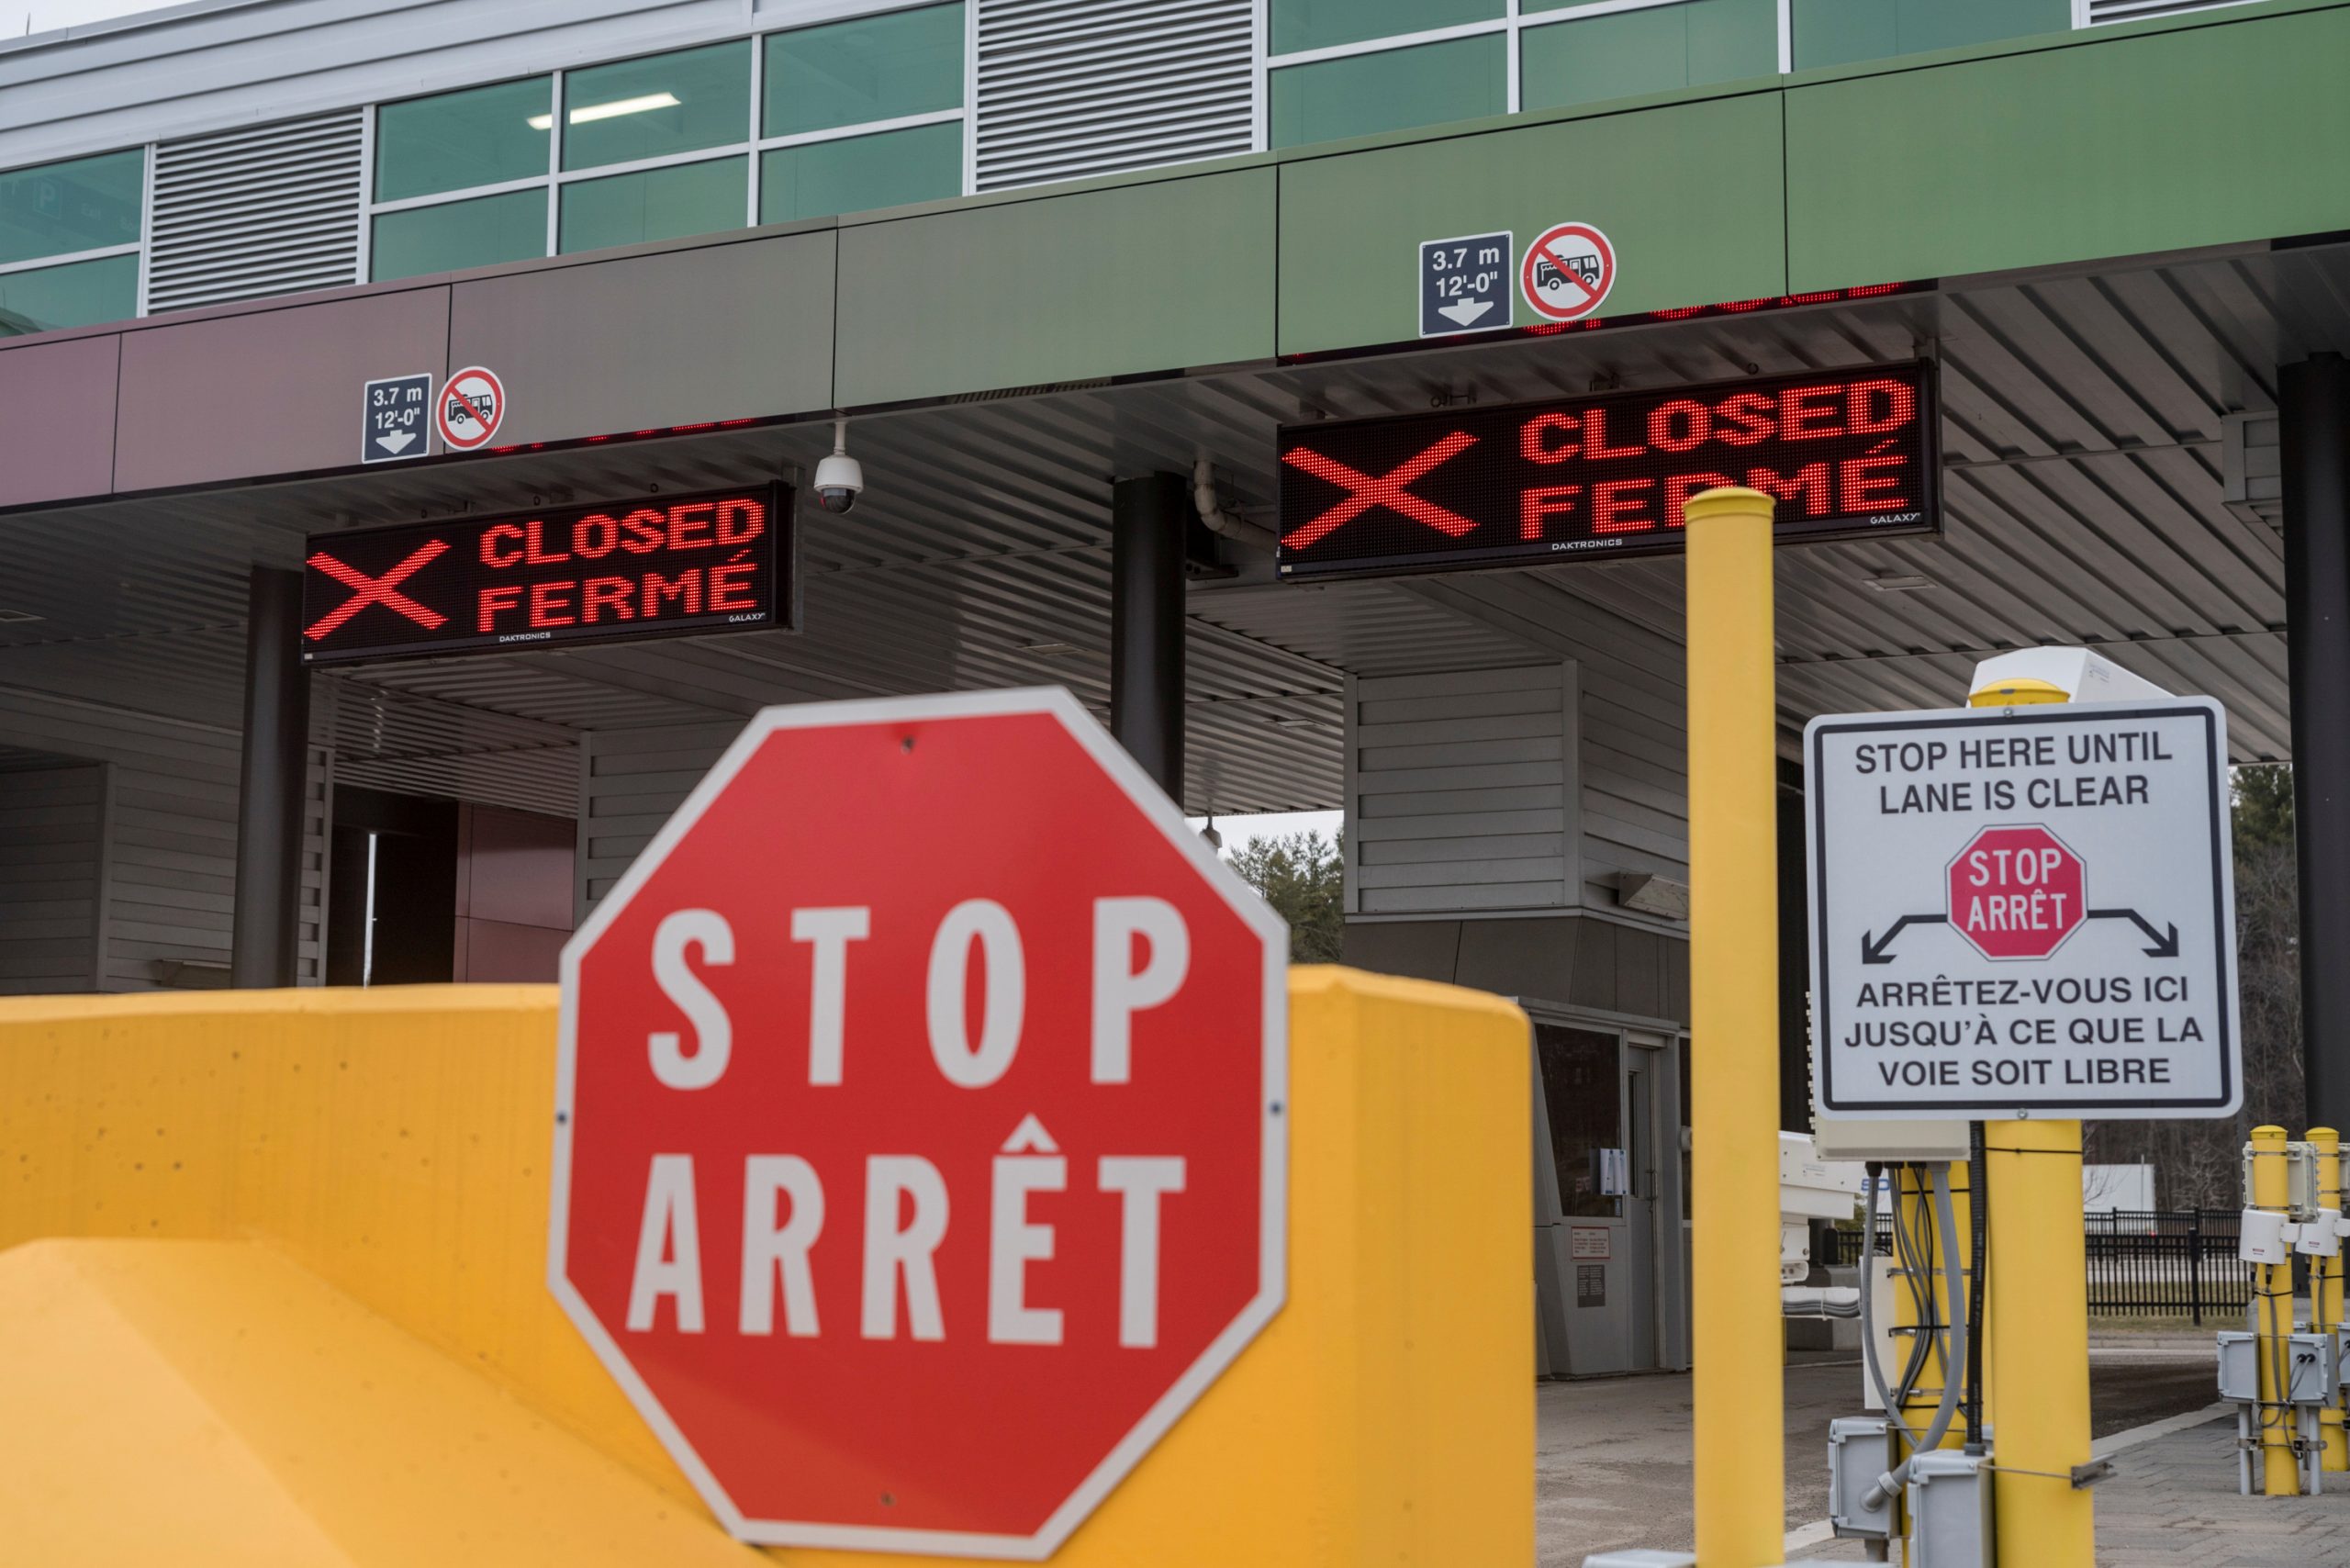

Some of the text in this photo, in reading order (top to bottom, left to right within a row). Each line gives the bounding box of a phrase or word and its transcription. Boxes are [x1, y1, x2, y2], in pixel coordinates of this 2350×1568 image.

[1432, 247, 1500, 271] 3.7 m
[373, 386, 422, 407] 3.7 m
[1520, 378, 1915, 465] CLOSED
[479, 498, 765, 568] CLOSED
[1551, 538, 1623, 551] DAKTRONICS
[477, 549, 757, 632] FERMÉ
[499, 632, 551, 643] DAKTRONICS
[1855, 731, 2173, 774] STOP HERE UNTIL
[1880, 775, 2149, 814] LANE IS CLEAR
[1968, 848, 2063, 887] STOP
[1967, 889, 2067, 932] ARRÊT
[647, 895, 1191, 1090] STOP
[1856, 974, 2188, 1008] ARRÊTEZ-VOUS ICI
[1844, 1013, 2204, 1047] JUSQU'À CE QUE LA
[1878, 1058, 2171, 1086] VOIE SOIT LIBRE
[625, 1113, 1186, 1349] ARRÊT
